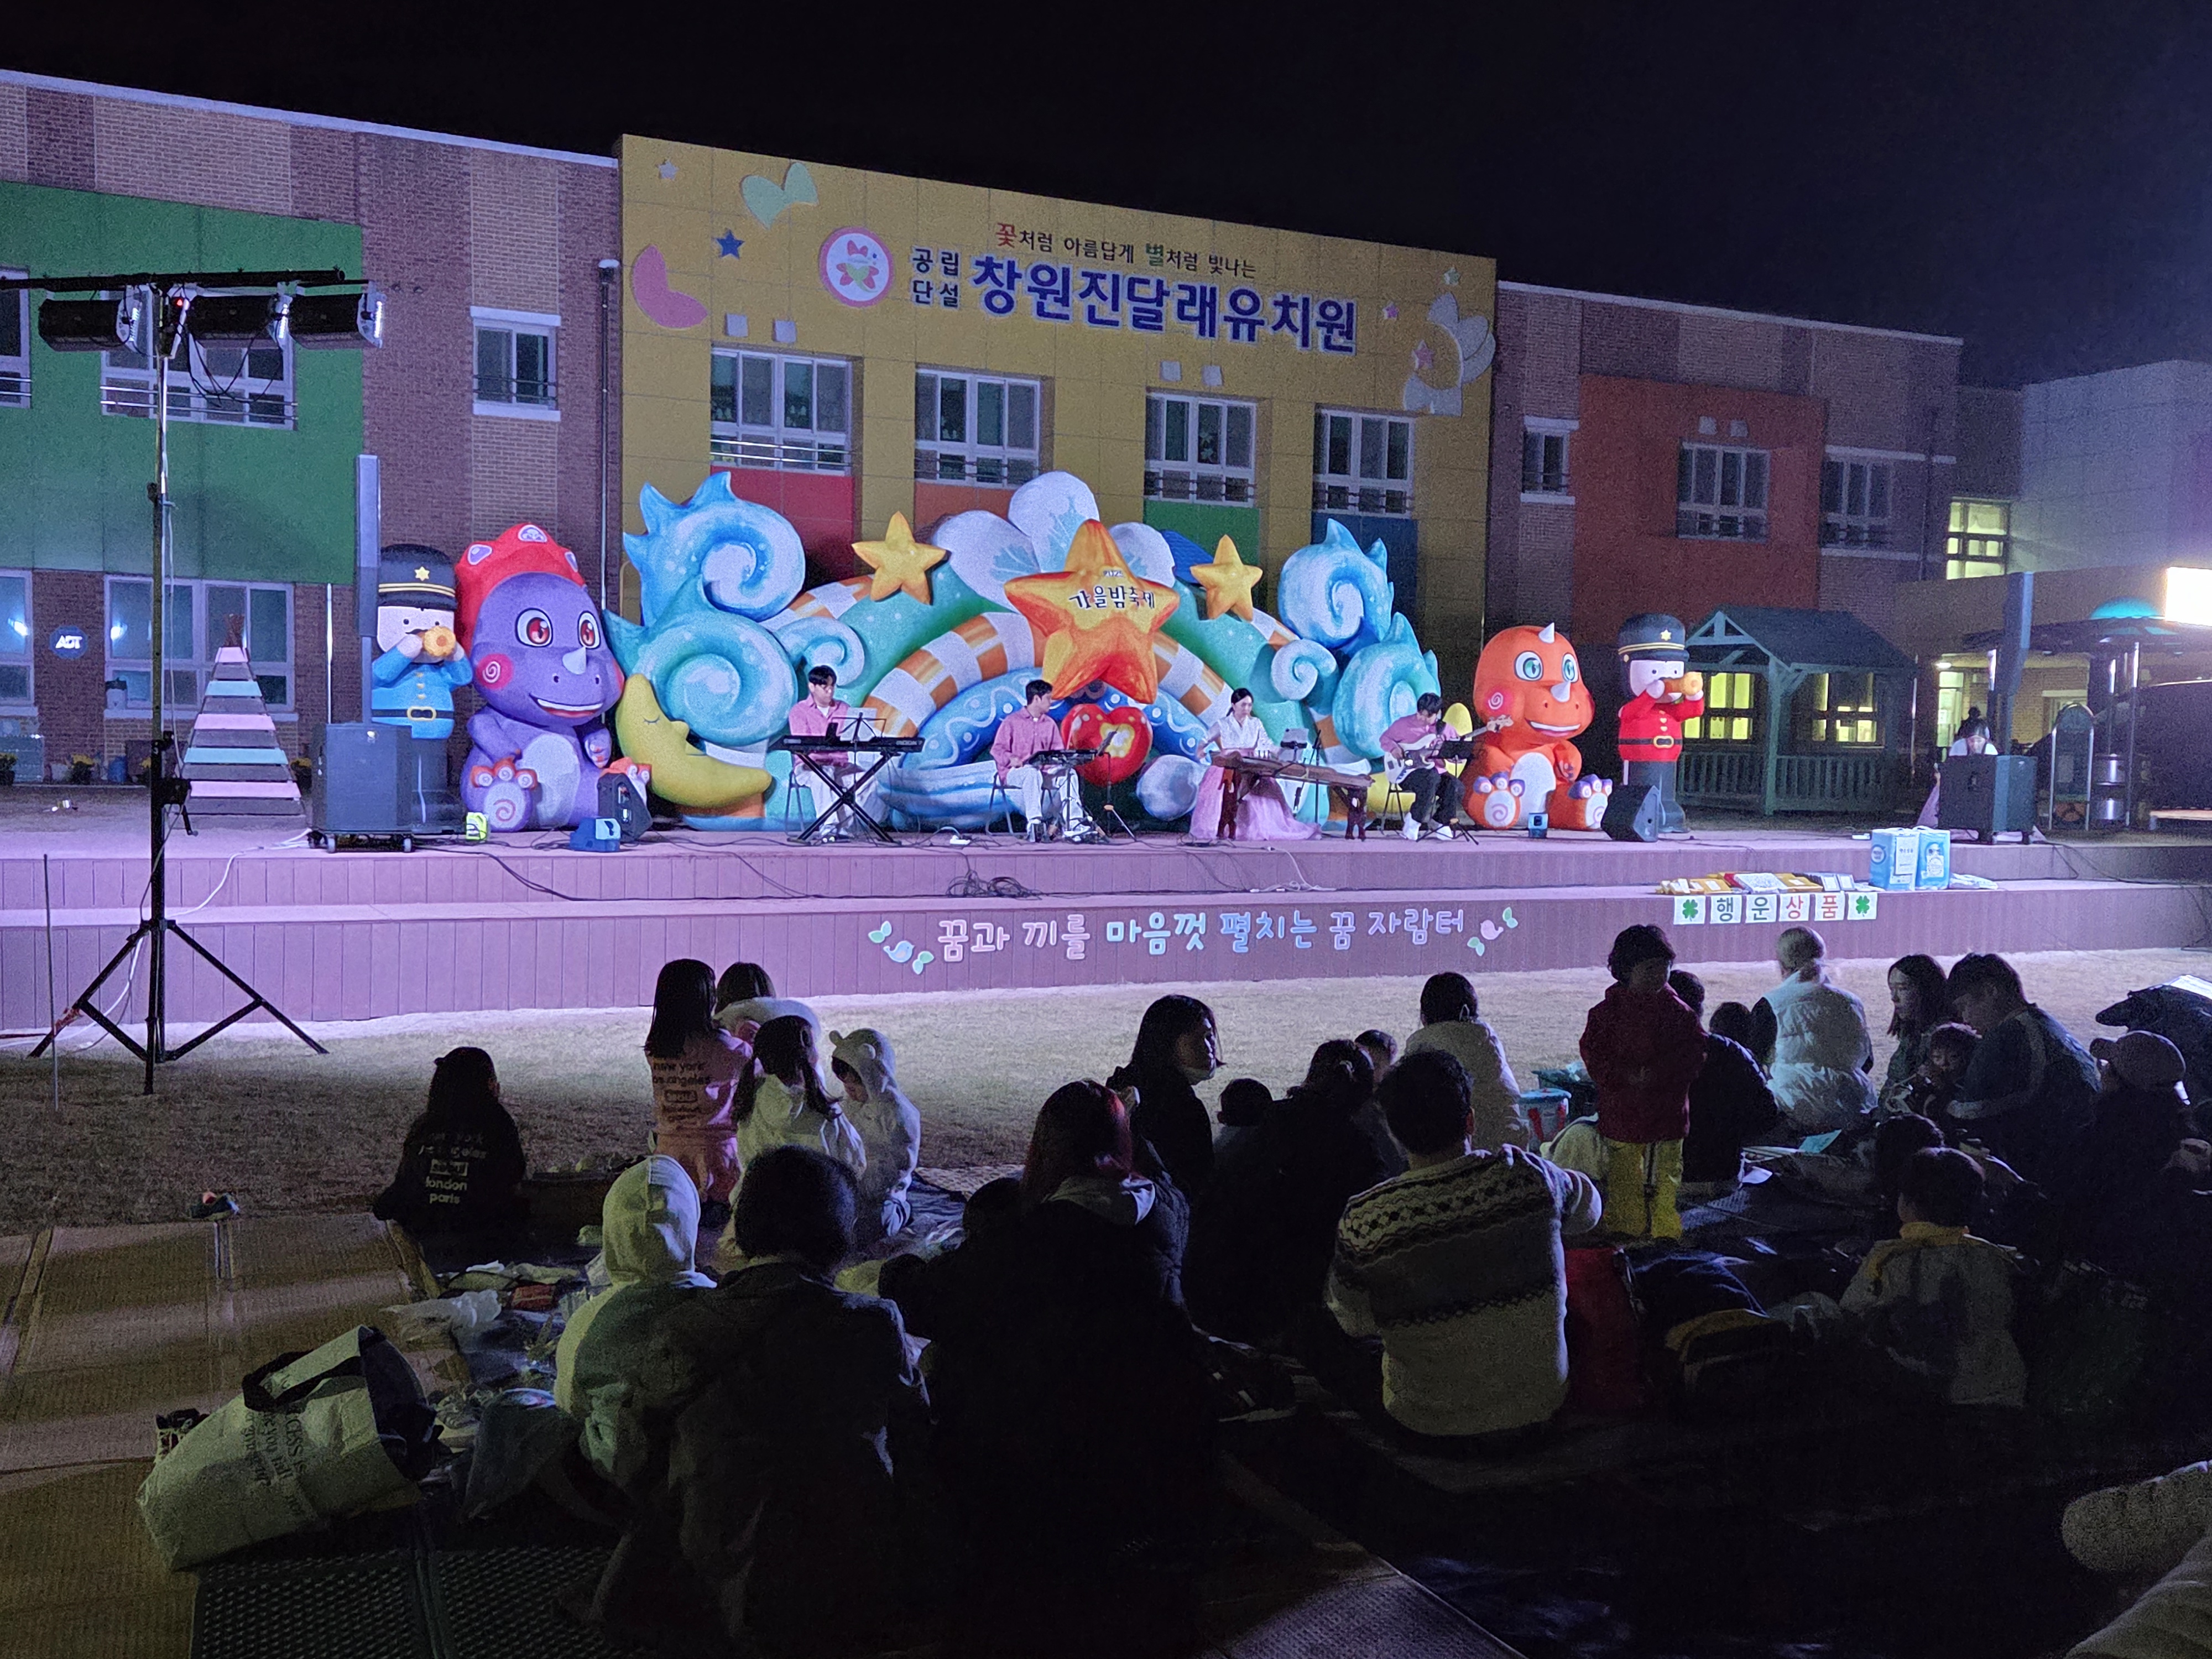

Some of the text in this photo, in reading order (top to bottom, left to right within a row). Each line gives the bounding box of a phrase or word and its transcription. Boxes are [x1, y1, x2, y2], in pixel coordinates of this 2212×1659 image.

[912, 248, 959, 276] 공립
[996, 222, 1257, 279] 꽃처럼 아름답게 별처럼 빛나는
[912, 279, 959, 308] 단설
[973, 255, 1354, 353] 창원진달래유치원
[55, 635, 83, 649] ADT
[938, 907, 1464, 962] 꿈과 끼를 마음껏 펼치는 꿈 자람터
[425, 1176, 468, 1191] london
[429, 1193, 461, 1204] paris
